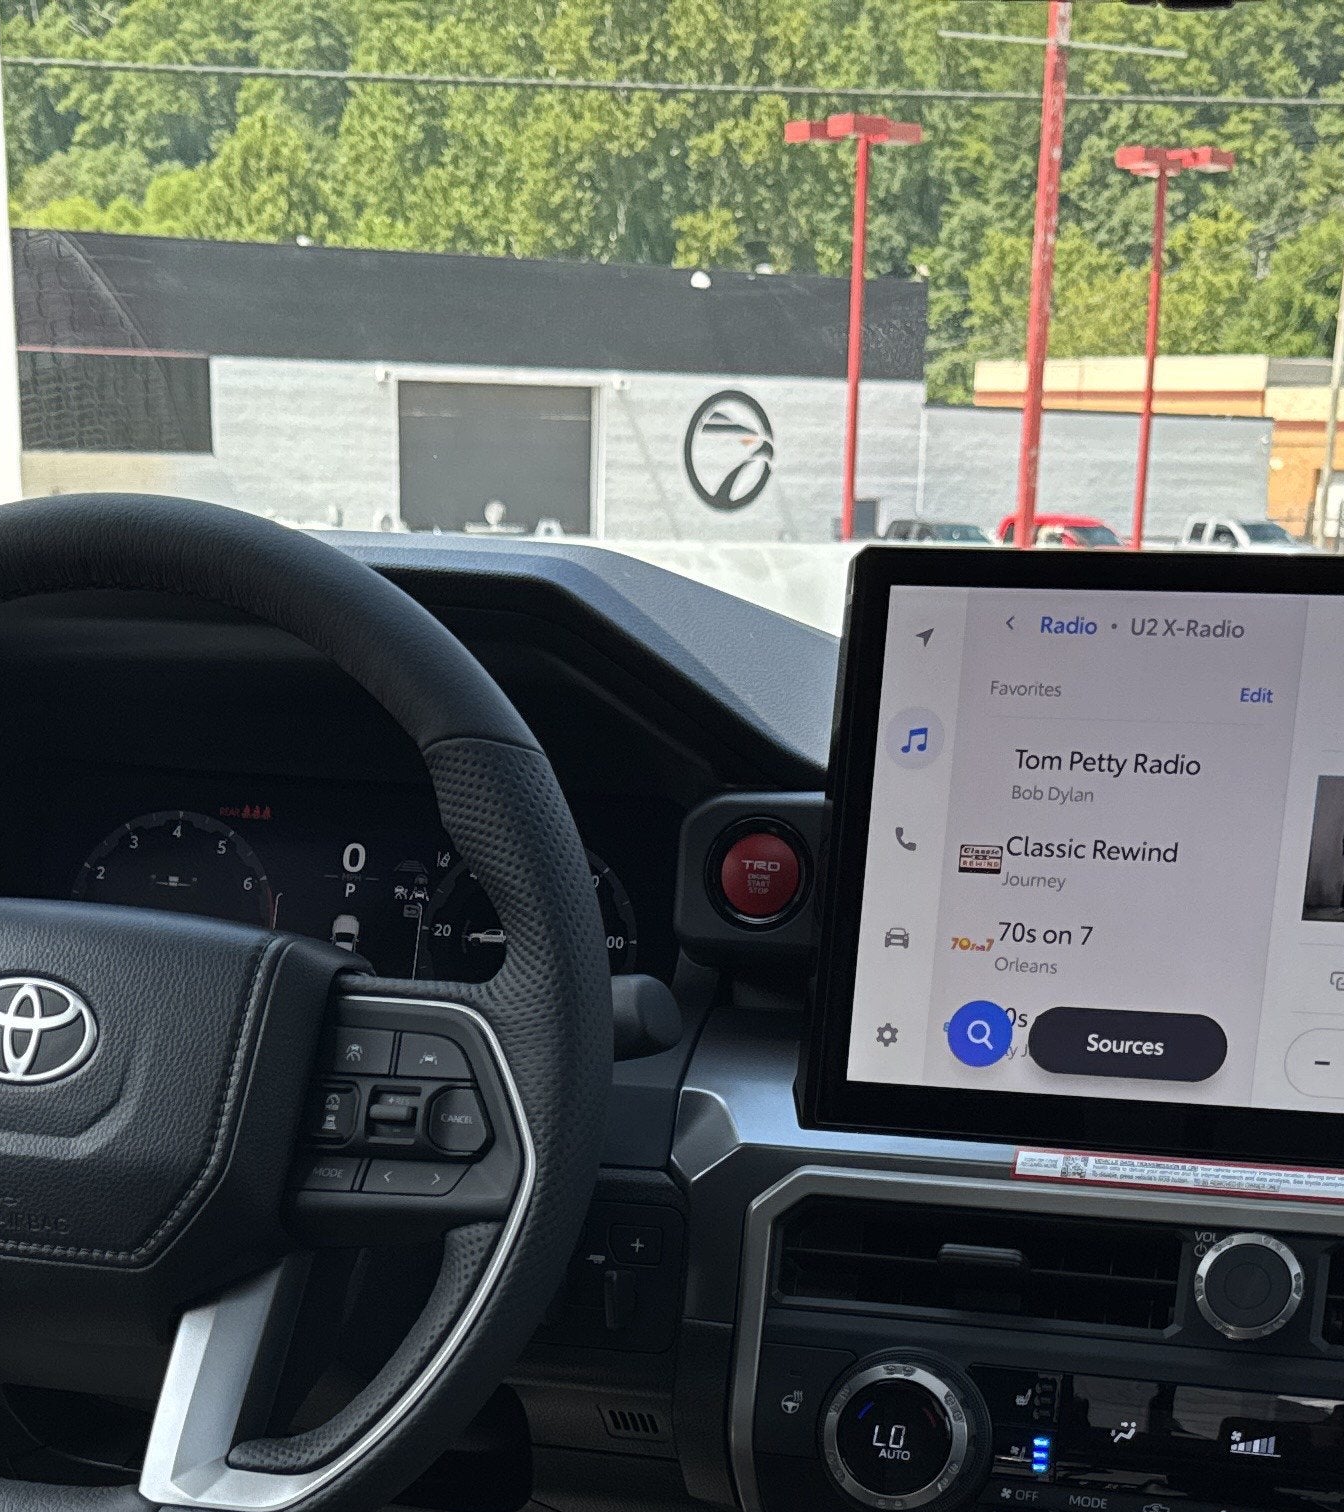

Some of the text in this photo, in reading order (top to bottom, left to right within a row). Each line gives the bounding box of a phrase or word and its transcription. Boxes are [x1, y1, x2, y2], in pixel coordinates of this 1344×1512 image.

[1040, 616, 1098, 637] Radio
[1130, 618, 1246, 640] U2 X-Radio
[990, 681, 1062, 699] Favorites
[1239, 687, 1274, 705] Edit
[1015, 749, 1202, 778] Tom Petty Radio
[1011, 785, 1095, 806] Bob Dylan
[172, 824, 182, 838] 4
[129, 835, 139, 850] 3
[216, 840, 227, 855] 5
[1006, 835, 1180, 864] Classic Rewind
[342, 842, 366, 873] 0
[96, 865, 106, 880] 2
[741, 859, 781, 872] TRD
[243, 877, 253, 891] 6
[1001, 871, 1067, 892] Journey
[345, 883, 356, 898] P
[433, 923, 452, 938] 20
[998, 921, 1094, 947] 70s on 7
[994, 955, 1059, 976] Orleans
[1086, 1034, 1165, 1057] Sources
[440, 1113, 474, 1125] CANCEL
[313, 1166, 344, 1179] MODE
[1194, 1231, 1218, 1243] VOL
[878, 1449, 911, 1462] AUTO
[1015, 1489, 1039, 1502] OFF
[1069, 1495, 1108, 1510] MODE
